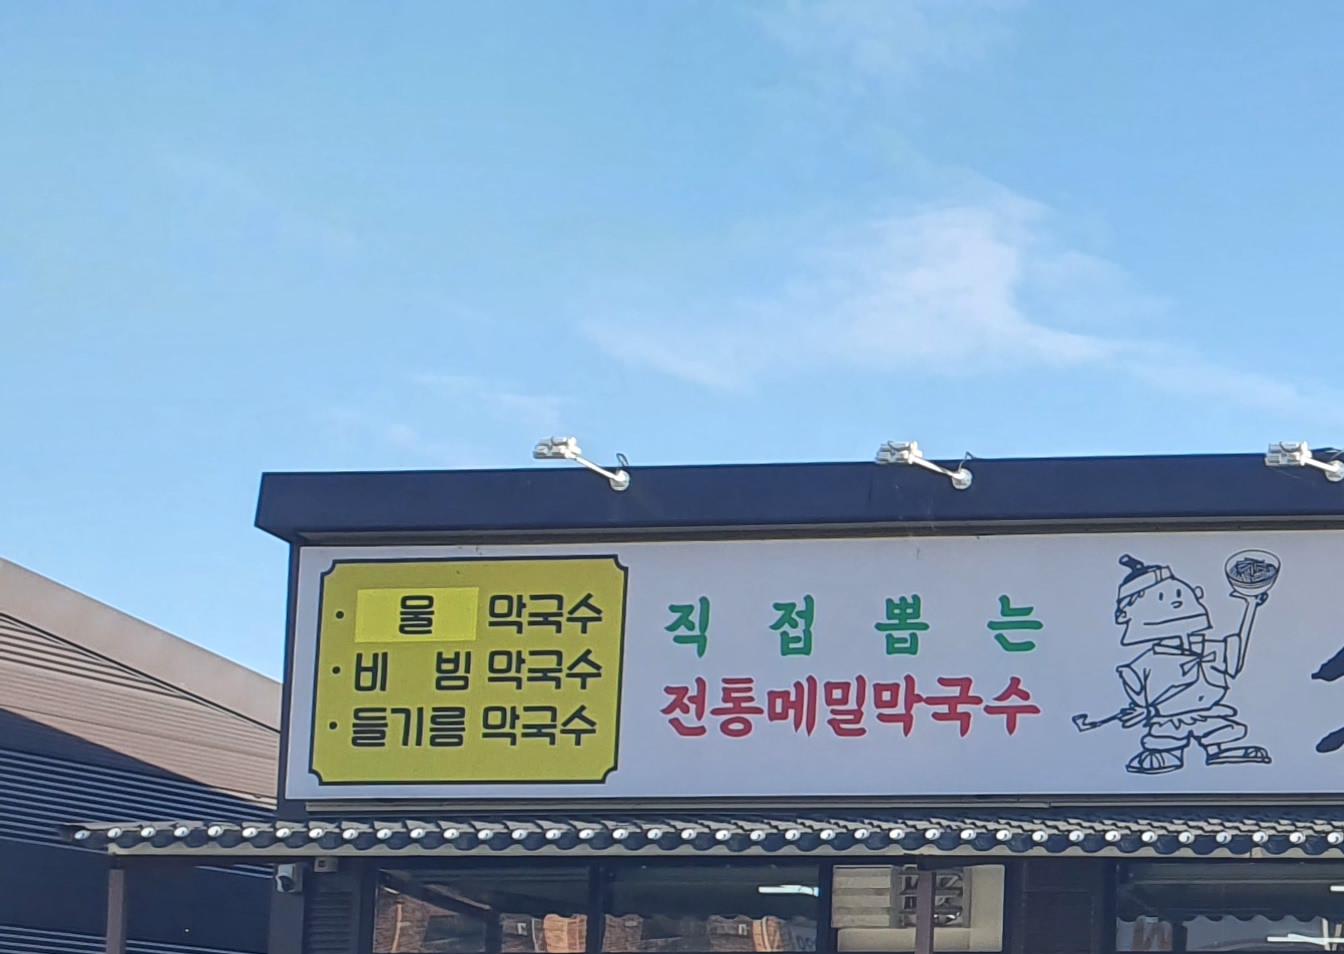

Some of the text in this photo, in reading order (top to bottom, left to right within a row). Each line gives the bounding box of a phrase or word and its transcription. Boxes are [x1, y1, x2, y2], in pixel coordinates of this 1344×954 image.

[488, 592, 603, 634] 막국수
[487, 648, 603, 690] 막국수
[351, 704, 598, 748] 들기름 막국수
[659, 673, 1042, 738] 전통메밀막국수
